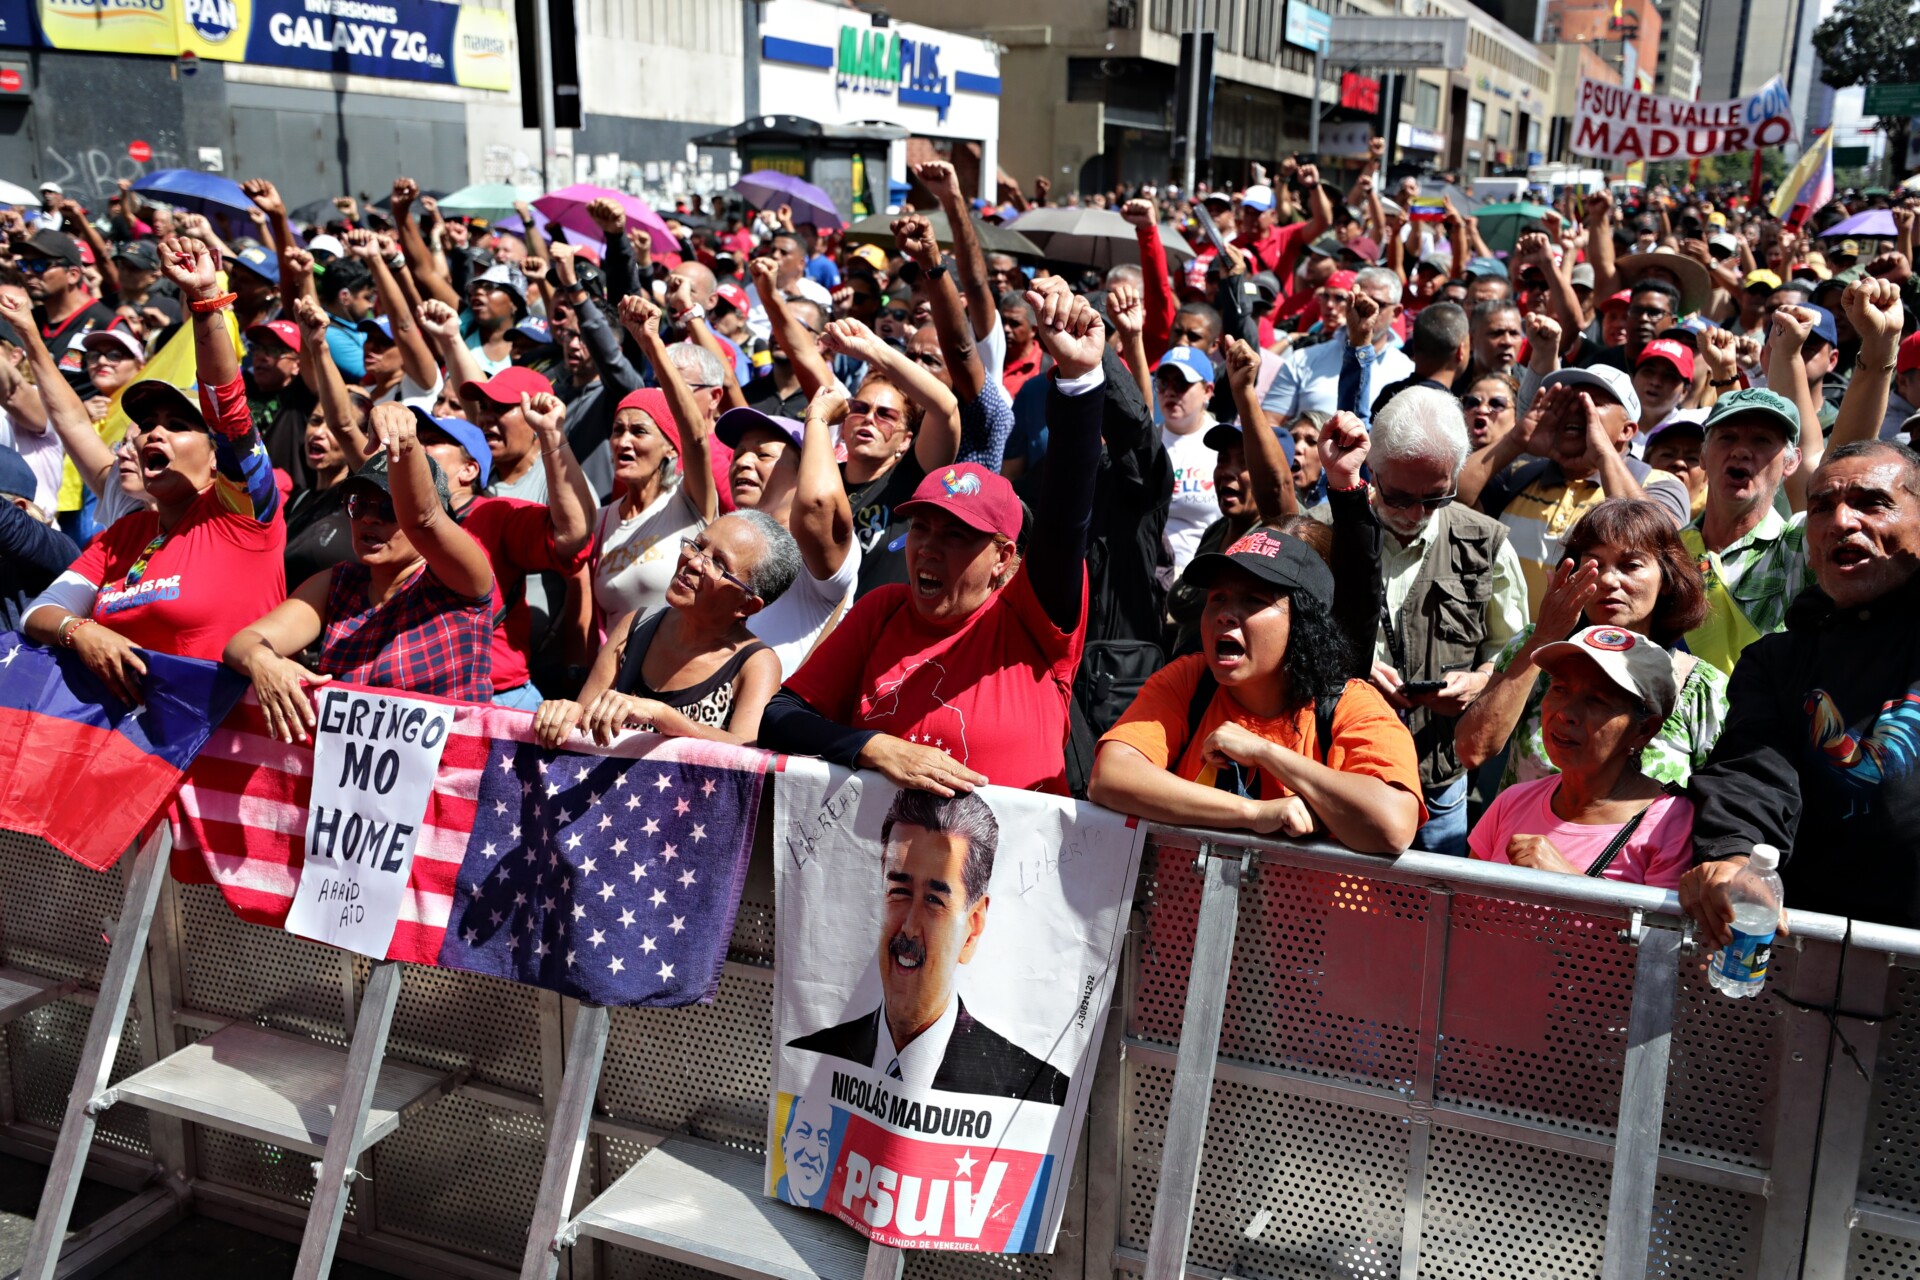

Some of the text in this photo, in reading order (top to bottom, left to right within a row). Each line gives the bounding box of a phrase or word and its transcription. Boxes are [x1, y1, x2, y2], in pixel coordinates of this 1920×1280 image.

[305, 0, 397, 25] INVERSIONES
[269, 12, 386, 58] GALAXY
[391, 30, 427, 63] ZG
[462, 33, 505, 54] mavesa
[1582, 78, 1789, 128] PSUV EL VALLE CON
[1575, 115, 1791, 158] MADURO
[141, 579, 155, 593] ES
[155, 574, 181, 590] PAZ
[311, 806, 414, 873] HOME
[1077, 975, 1095, 1029] J-306211292
[831, 1071, 992, 1140] NICOLÁS MADURO
[855, 1219, 885, 1242] SOCIALISTA
[888, 1236, 916, 1248] UNIDO
[919, 1240, 930, 1249] DE
[933, 1241, 980, 1251] VENEZUELA
